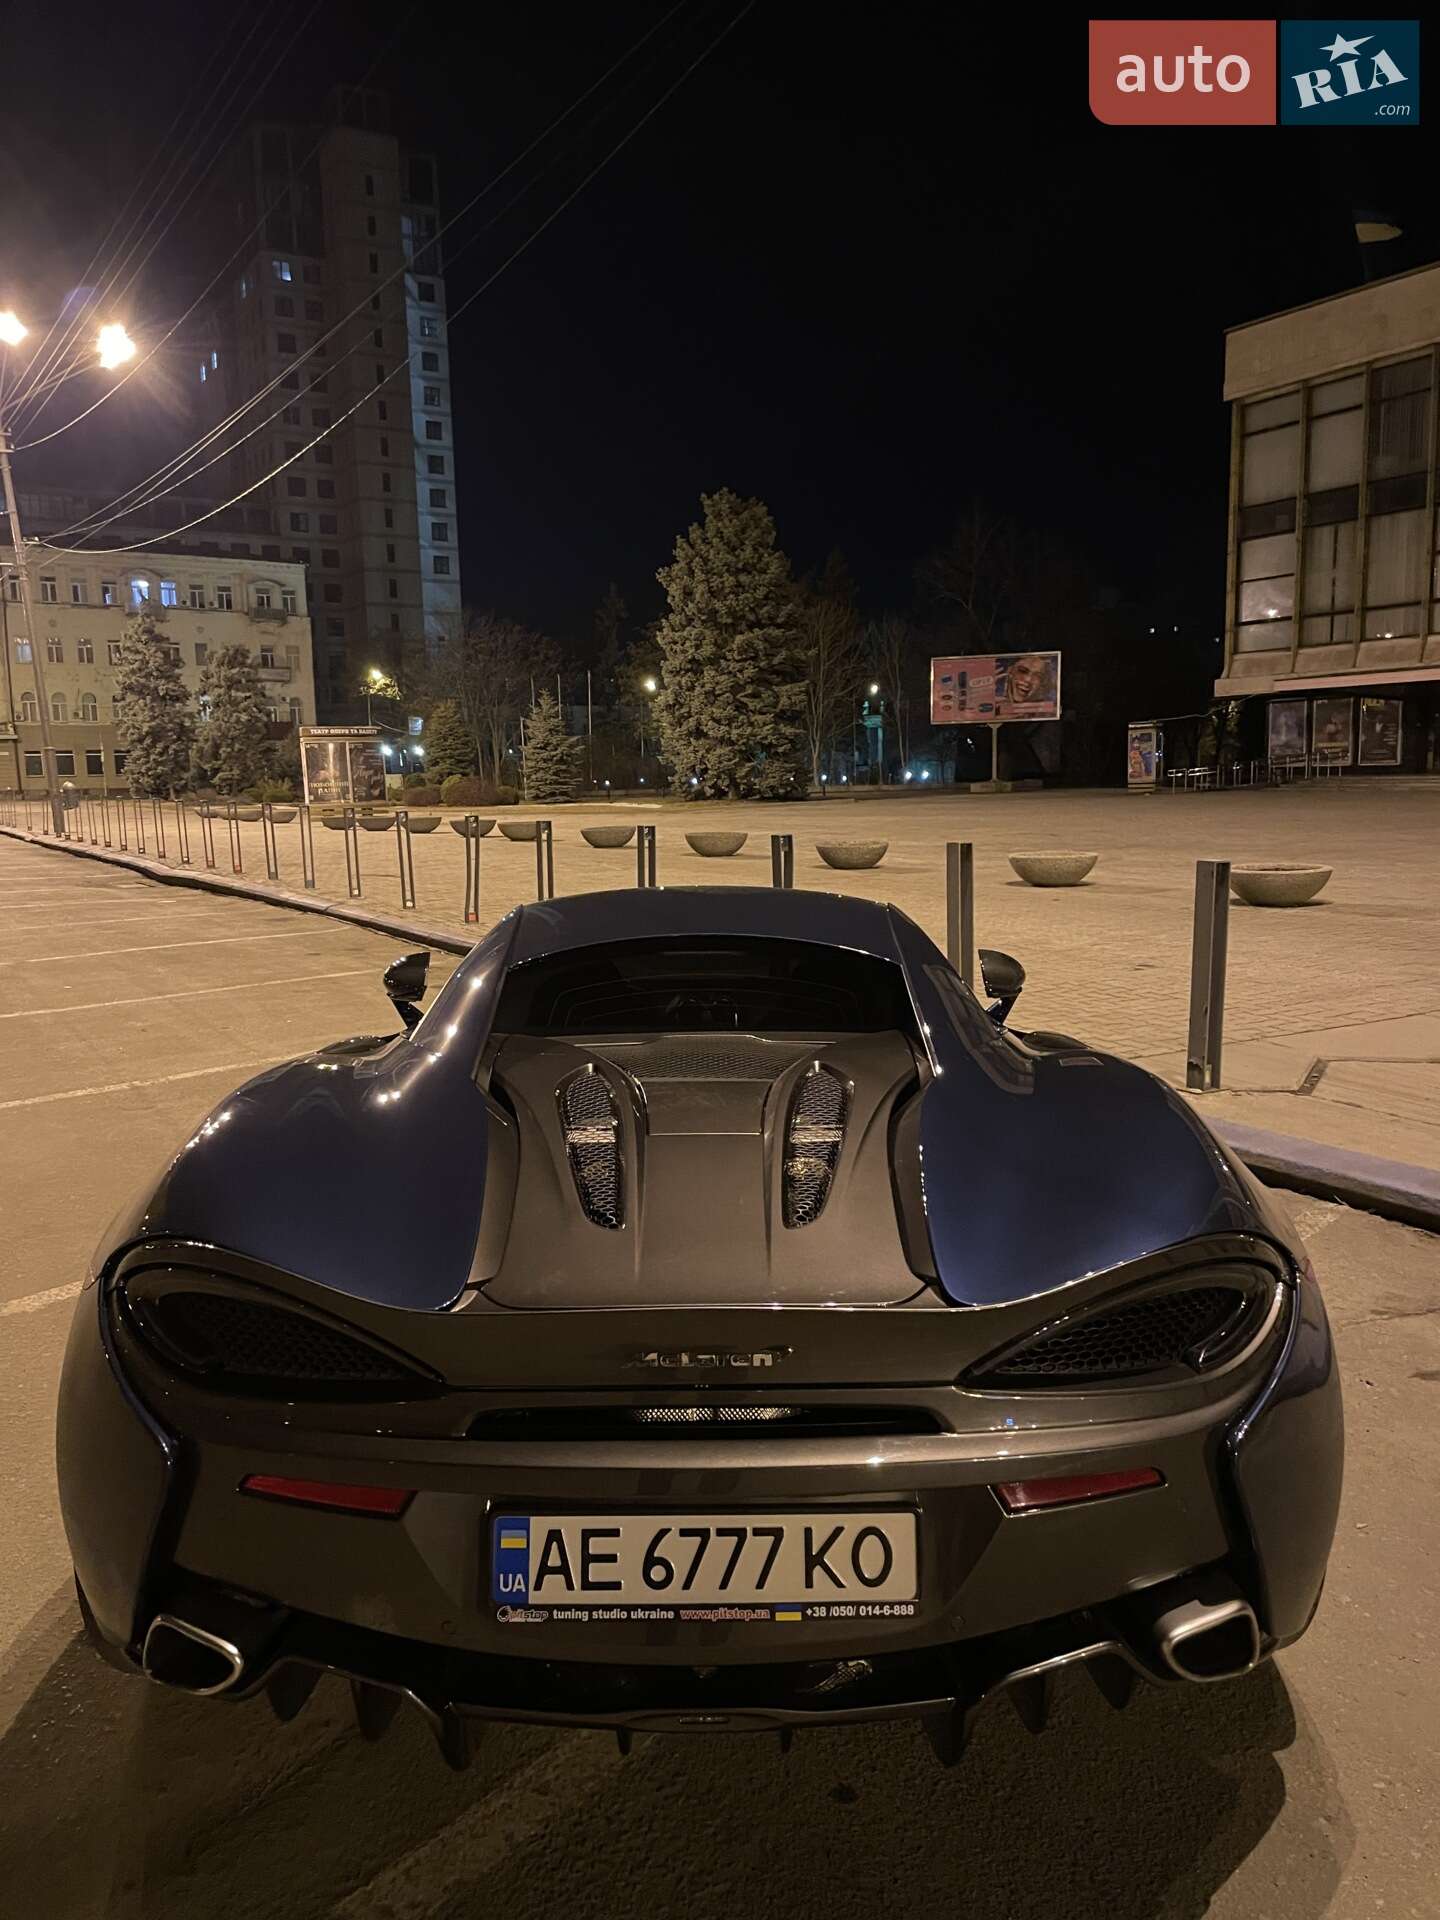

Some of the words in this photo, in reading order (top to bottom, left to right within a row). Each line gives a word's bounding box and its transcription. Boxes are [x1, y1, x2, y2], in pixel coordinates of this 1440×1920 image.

[533, 1527, 623, 1592] AE
[642, 1526, 785, 1591] 6777
[804, 1525, 893, 1589] KO
[500, 1573, 526, 1593] UA
[553, 1608, 589, 1621] tuning
[592, 1608, 627, 1620] studio
[631, 1608, 675, 1619] ukraine
[680, 1607, 770, 1621] www.pitstop.ua
[806, 1606, 827, 1617] +38
[829, 1605, 857, 1617] /050/
[859, 1604, 915, 1616] 014-6-888
